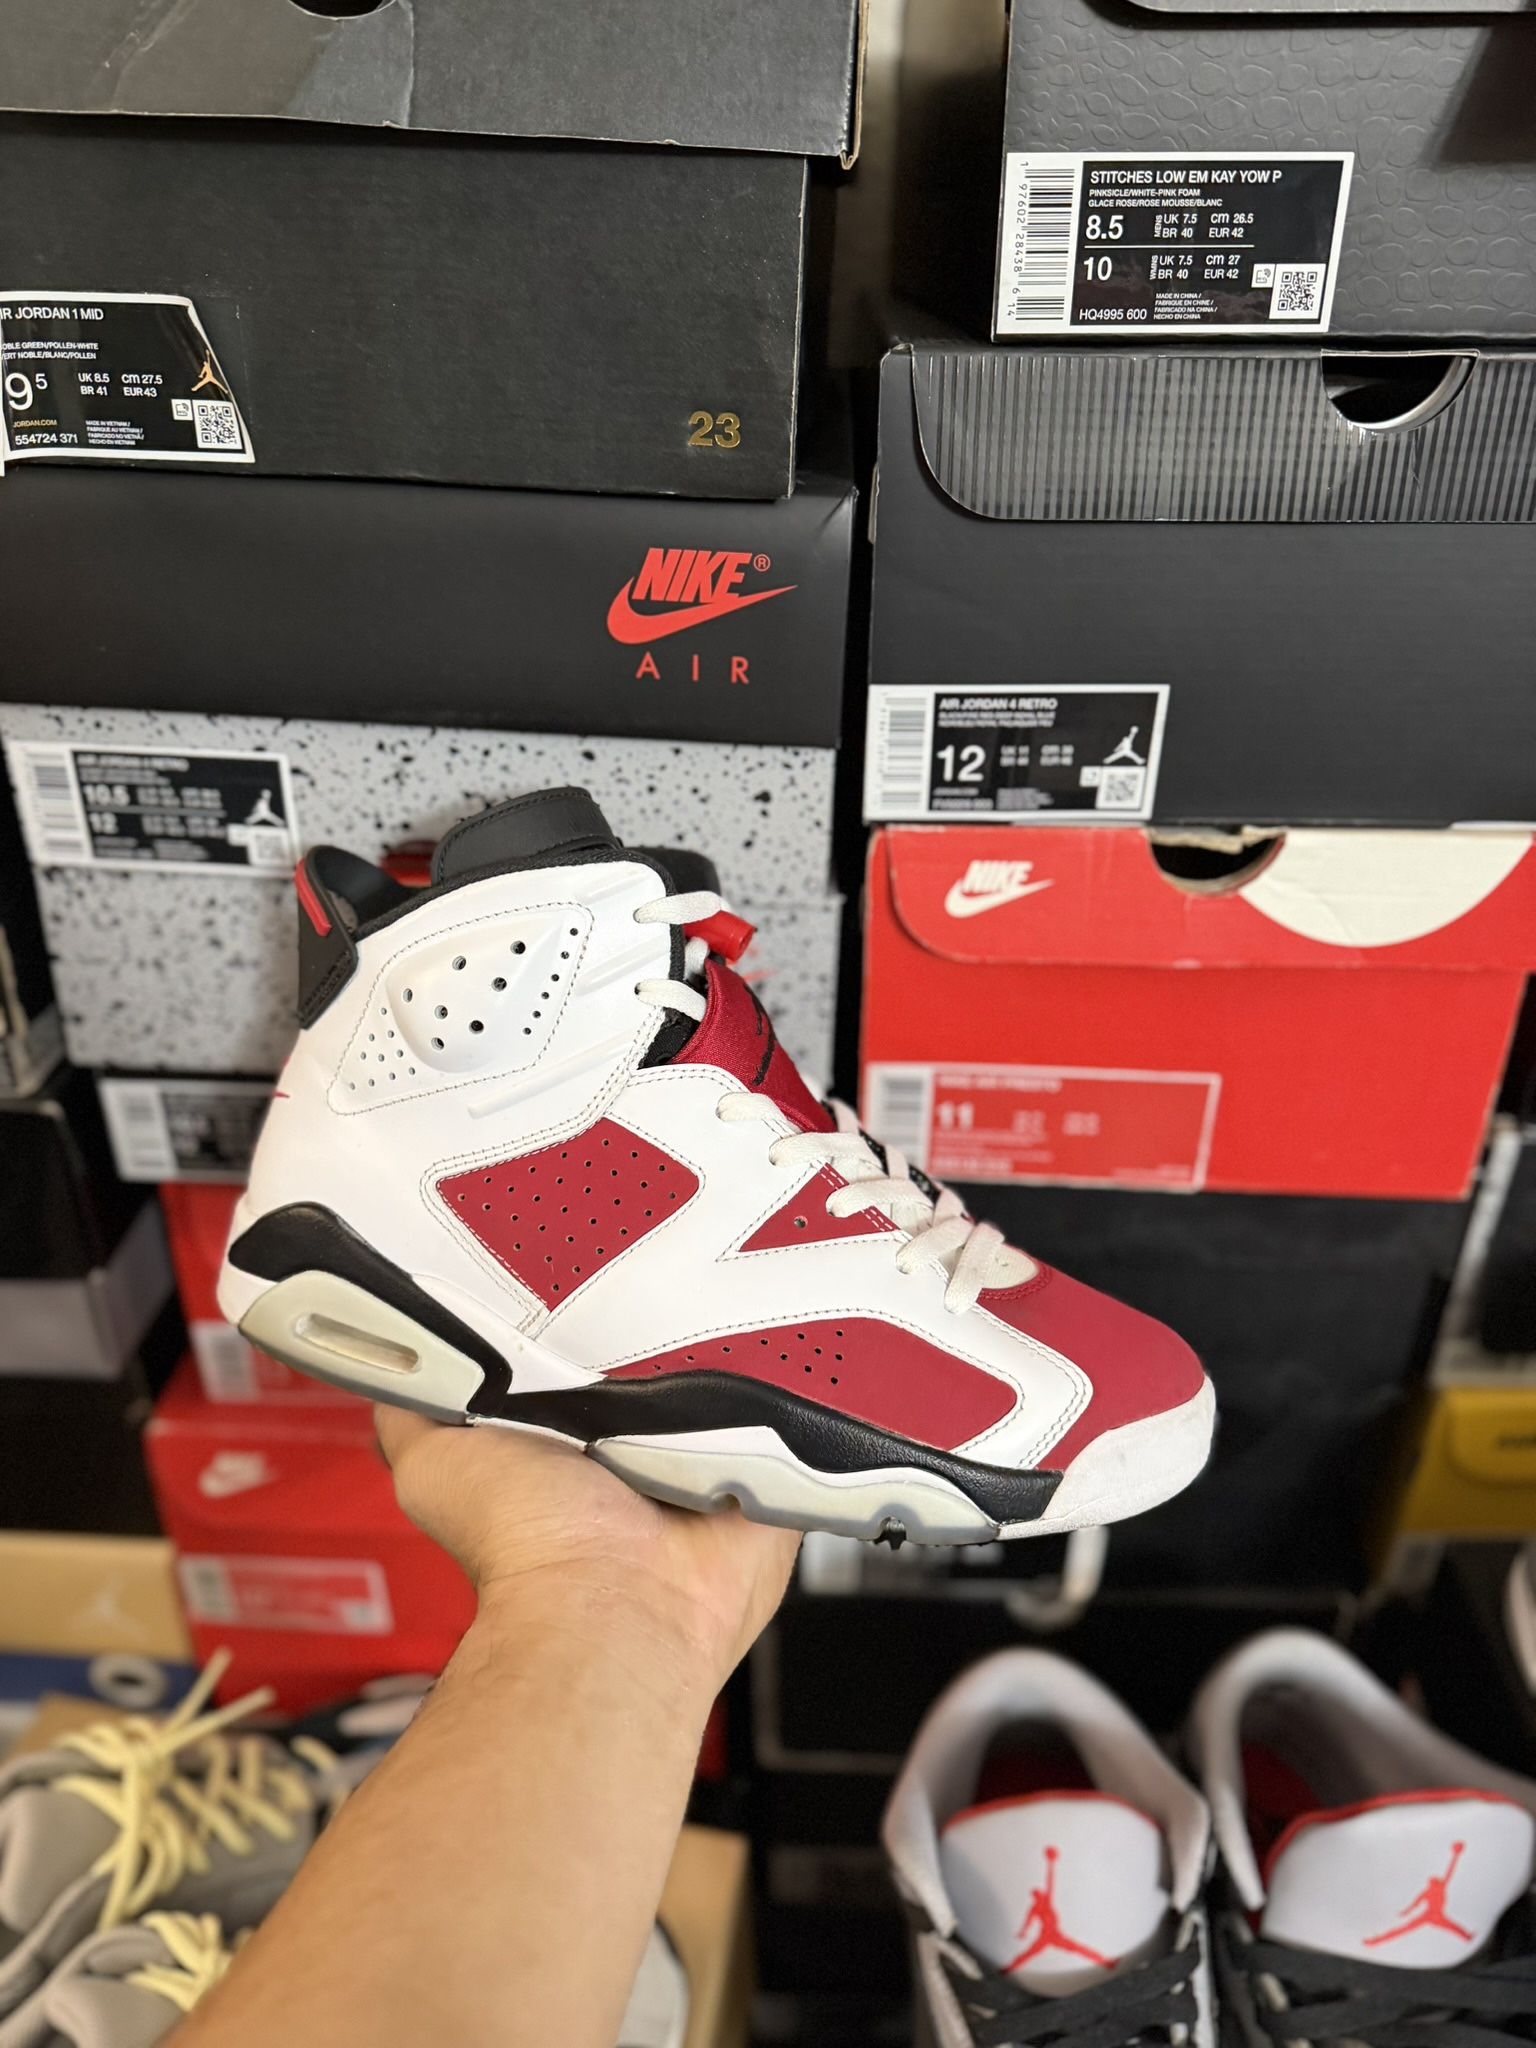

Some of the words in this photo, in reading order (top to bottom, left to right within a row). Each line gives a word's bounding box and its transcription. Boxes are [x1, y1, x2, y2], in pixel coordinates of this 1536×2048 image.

[1090, 170, 1152, 184] STITCHES
[1156, 170, 1186, 184] LOW
[1188, 170, 1208, 184] EM
[1211, 170, 1237, 183] KAY
[1240, 170, 1270, 183] YOW
[1272, 170, 1282, 182] P
[1089, 188, 1176, 197] PINKSICLE/WHITE-PINK
[1016, 184, 1028, 224] 97602
[1116, 199, 1160, 207] ROSE/ROSE
[1162, 198, 1222, 206] MOUSSE/BLANC
[1164, 214, 1179, 224] UK
[1183, 214, 1198, 224] 7.5
[1210, 214, 1230, 224] cm
[1233, 214, 1254, 224] 26.5
[1085, 214, 1124, 240] 8.5
[1154, 214, 1162, 238] MENS
[1162, 228, 1178, 238] BR
[1181, 228, 1194, 238] 40
[1208, 228, 1229, 238] EUR
[1232, 228, 1244, 238] 42
[1014, 234, 1024, 272] 28438
[1160, 255, 1174, 266] UK
[1178, 255, 1193, 266] 7.5
[1206, 255, 1224, 265] cm
[1228, 255, 1240, 265] 27
[1083, 256, 1112, 281] 10
[1150, 255, 1158, 280] WMNS
[1158, 269, 1172, 280] BR
[1176, 269, 1188, 280] 40
[1204, 269, 1225, 279] EUR
[1226, 268, 1239, 279] 42
[0, 308, 12, 320] IR
[15, 307, 70, 319] JORDAN
[72, 308, 78, 319] 1
[81, 308, 104, 320] MID
[1079, 309, 1124, 320] HQ4995
[1126, 309, 1147, 320] 600
[78, 373, 93, 383] UK
[94, 373, 110, 383] 8.5
[122, 374, 140, 384] cm
[142, 374, 163, 384] 27.5
[5, 372, 33, 410] 9
[35, 374, 48, 390] 5
[80, 386, 94, 395] BR
[96, 386, 108, 396] 41
[124, 387, 142, 396] EUR
[144, 387, 157, 397] 43
[13, 420, 57, 428] JORDAN.COM
[688, 411, 741, 448] 23
[15, 434, 58, 445] 554724
[60, 433, 78, 443] 371
[632, 548, 752, 603] NIKE
[636, 651, 749, 684] AIR
[961, 698, 1008, 710] JORDAN
[1018, 698, 1058, 710] RETRO
[936, 744, 986, 782] 12
[961, 860, 1034, 893] NIKE
